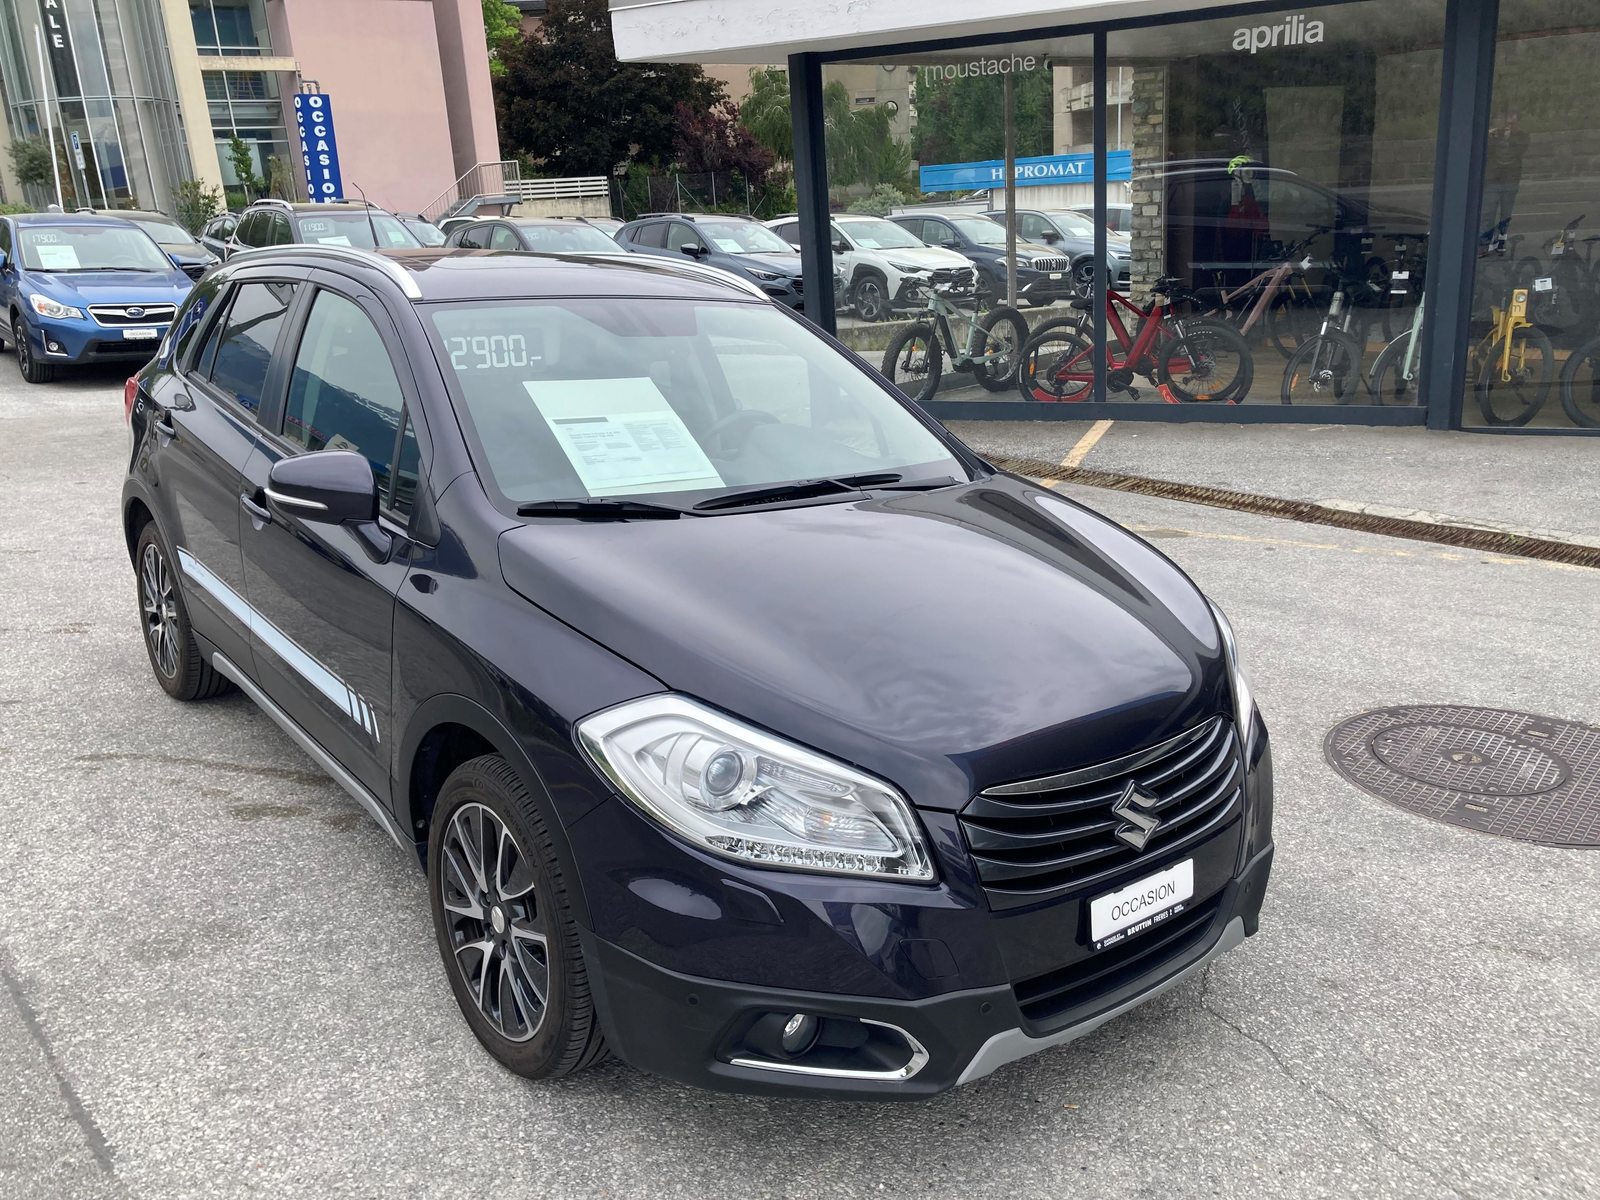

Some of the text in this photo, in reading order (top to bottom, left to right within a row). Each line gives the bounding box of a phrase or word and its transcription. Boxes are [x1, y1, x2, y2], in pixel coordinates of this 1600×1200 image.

[1232, 14, 1324, 54] aprilia
[924, 53, 1036, 88] moustache
[991, 162, 1086, 180] HPROMAT
[1111, 881, 1176, 921] OCCASION
